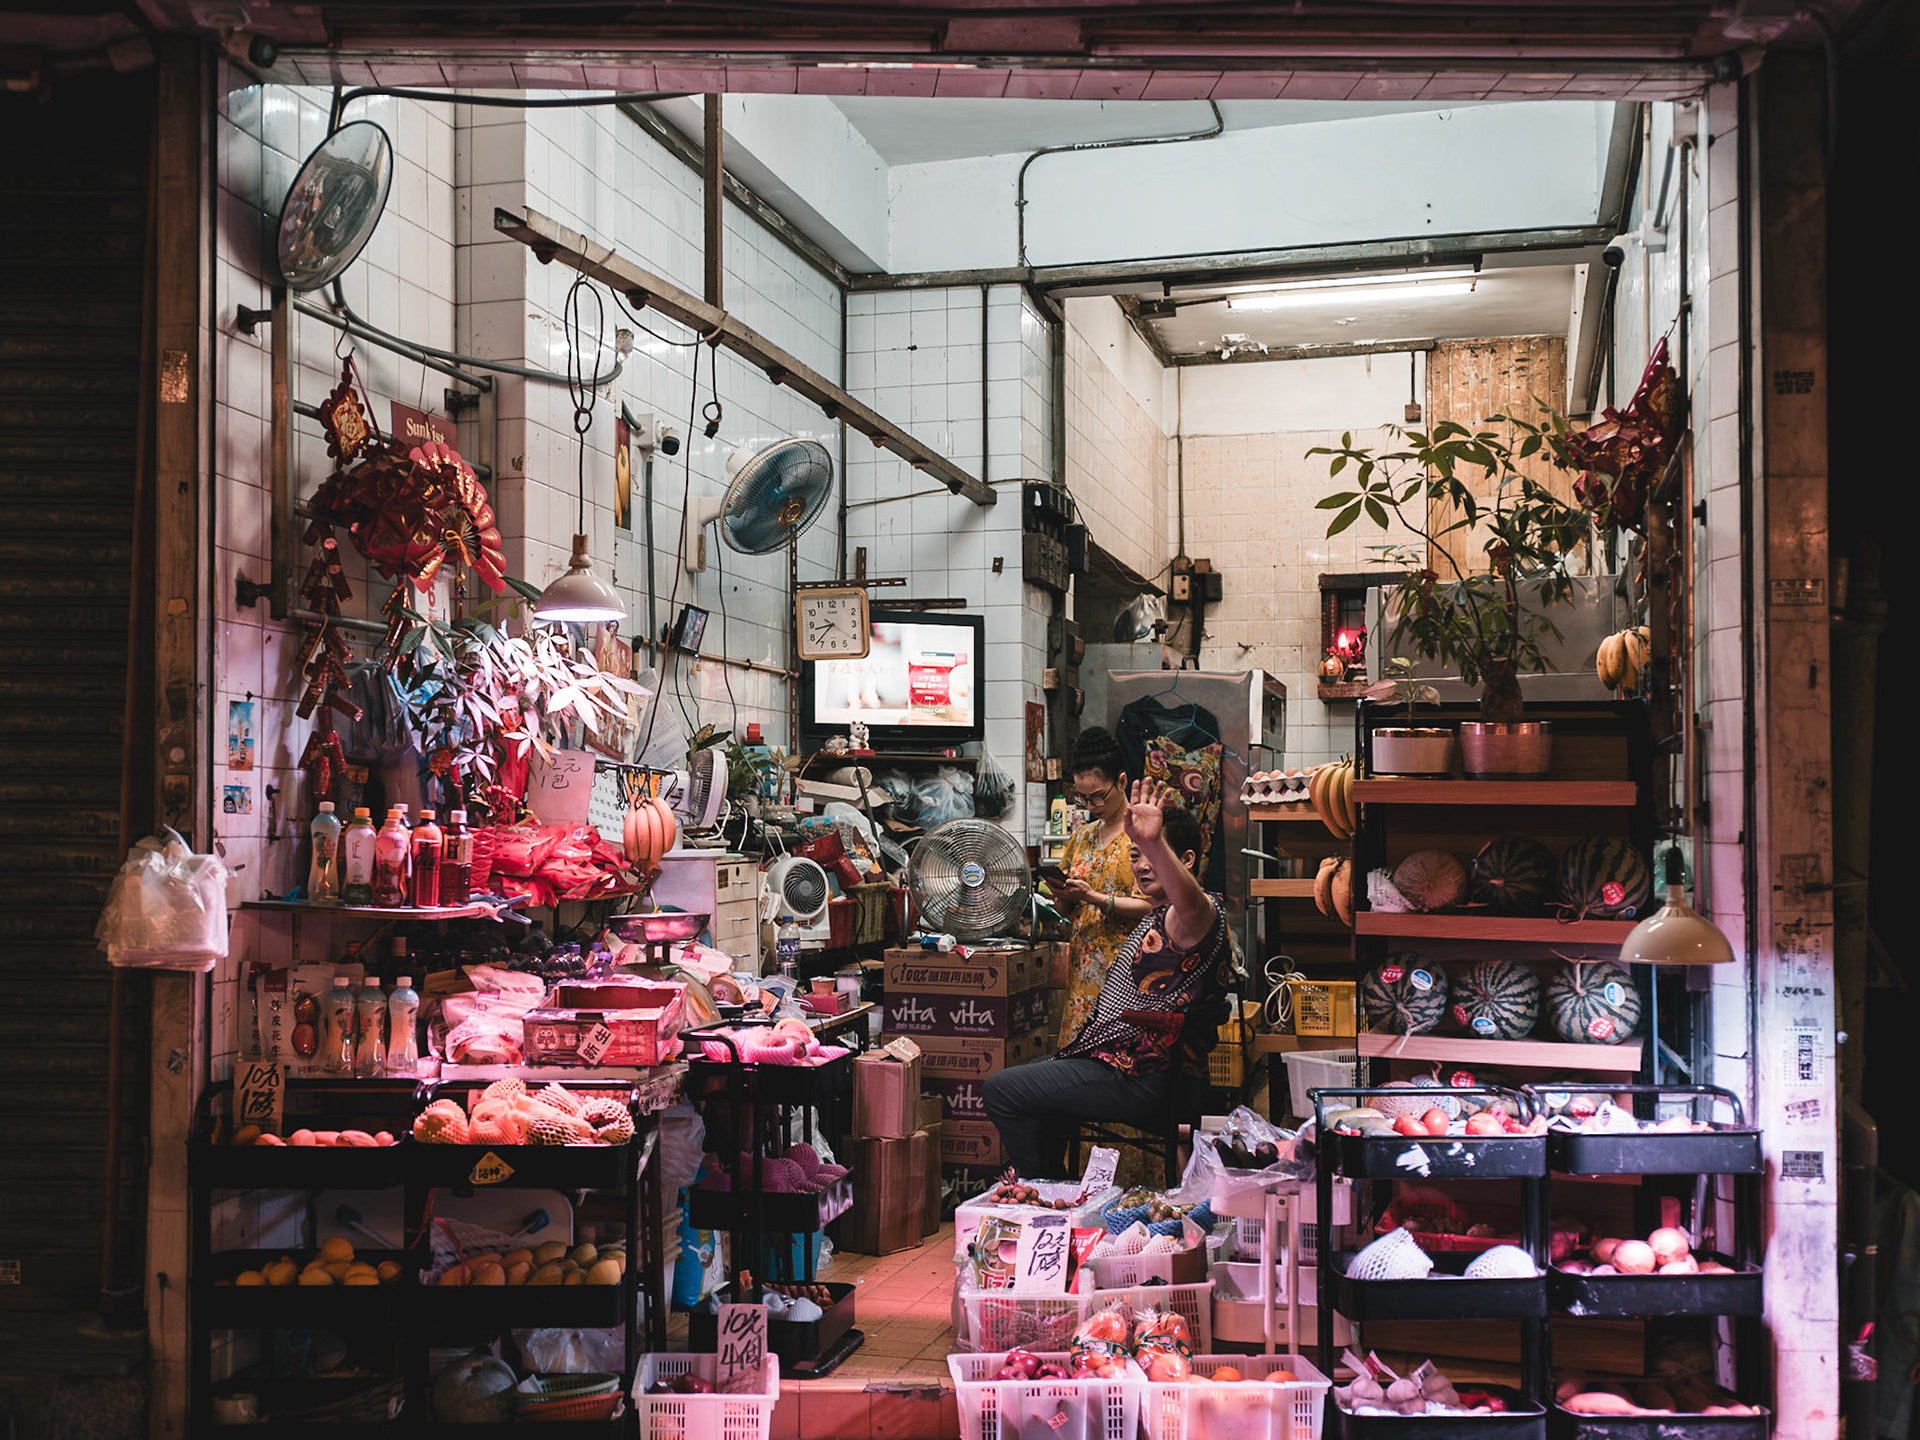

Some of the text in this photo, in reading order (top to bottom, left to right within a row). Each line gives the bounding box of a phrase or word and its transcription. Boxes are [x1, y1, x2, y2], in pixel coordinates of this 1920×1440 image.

[406, 417, 446, 445] Sunkist
[808, 608, 816, 616] 10
[828, 600, 836, 608] 12
[850, 608, 856, 616] 2
[852, 620, 856, 628] 3
[810, 634, 815, 642] 8
[540, 757, 581, 773] 12元
[540, 774, 570, 789] 1包
[891, 997, 995, 1026] vita vita
[582, 1028, 612, 1060] 新生
[240, 1062, 280, 1090] 10元
[1032, 1228, 1068, 1250] 12元
[722, 1308, 764, 1341] 10元
